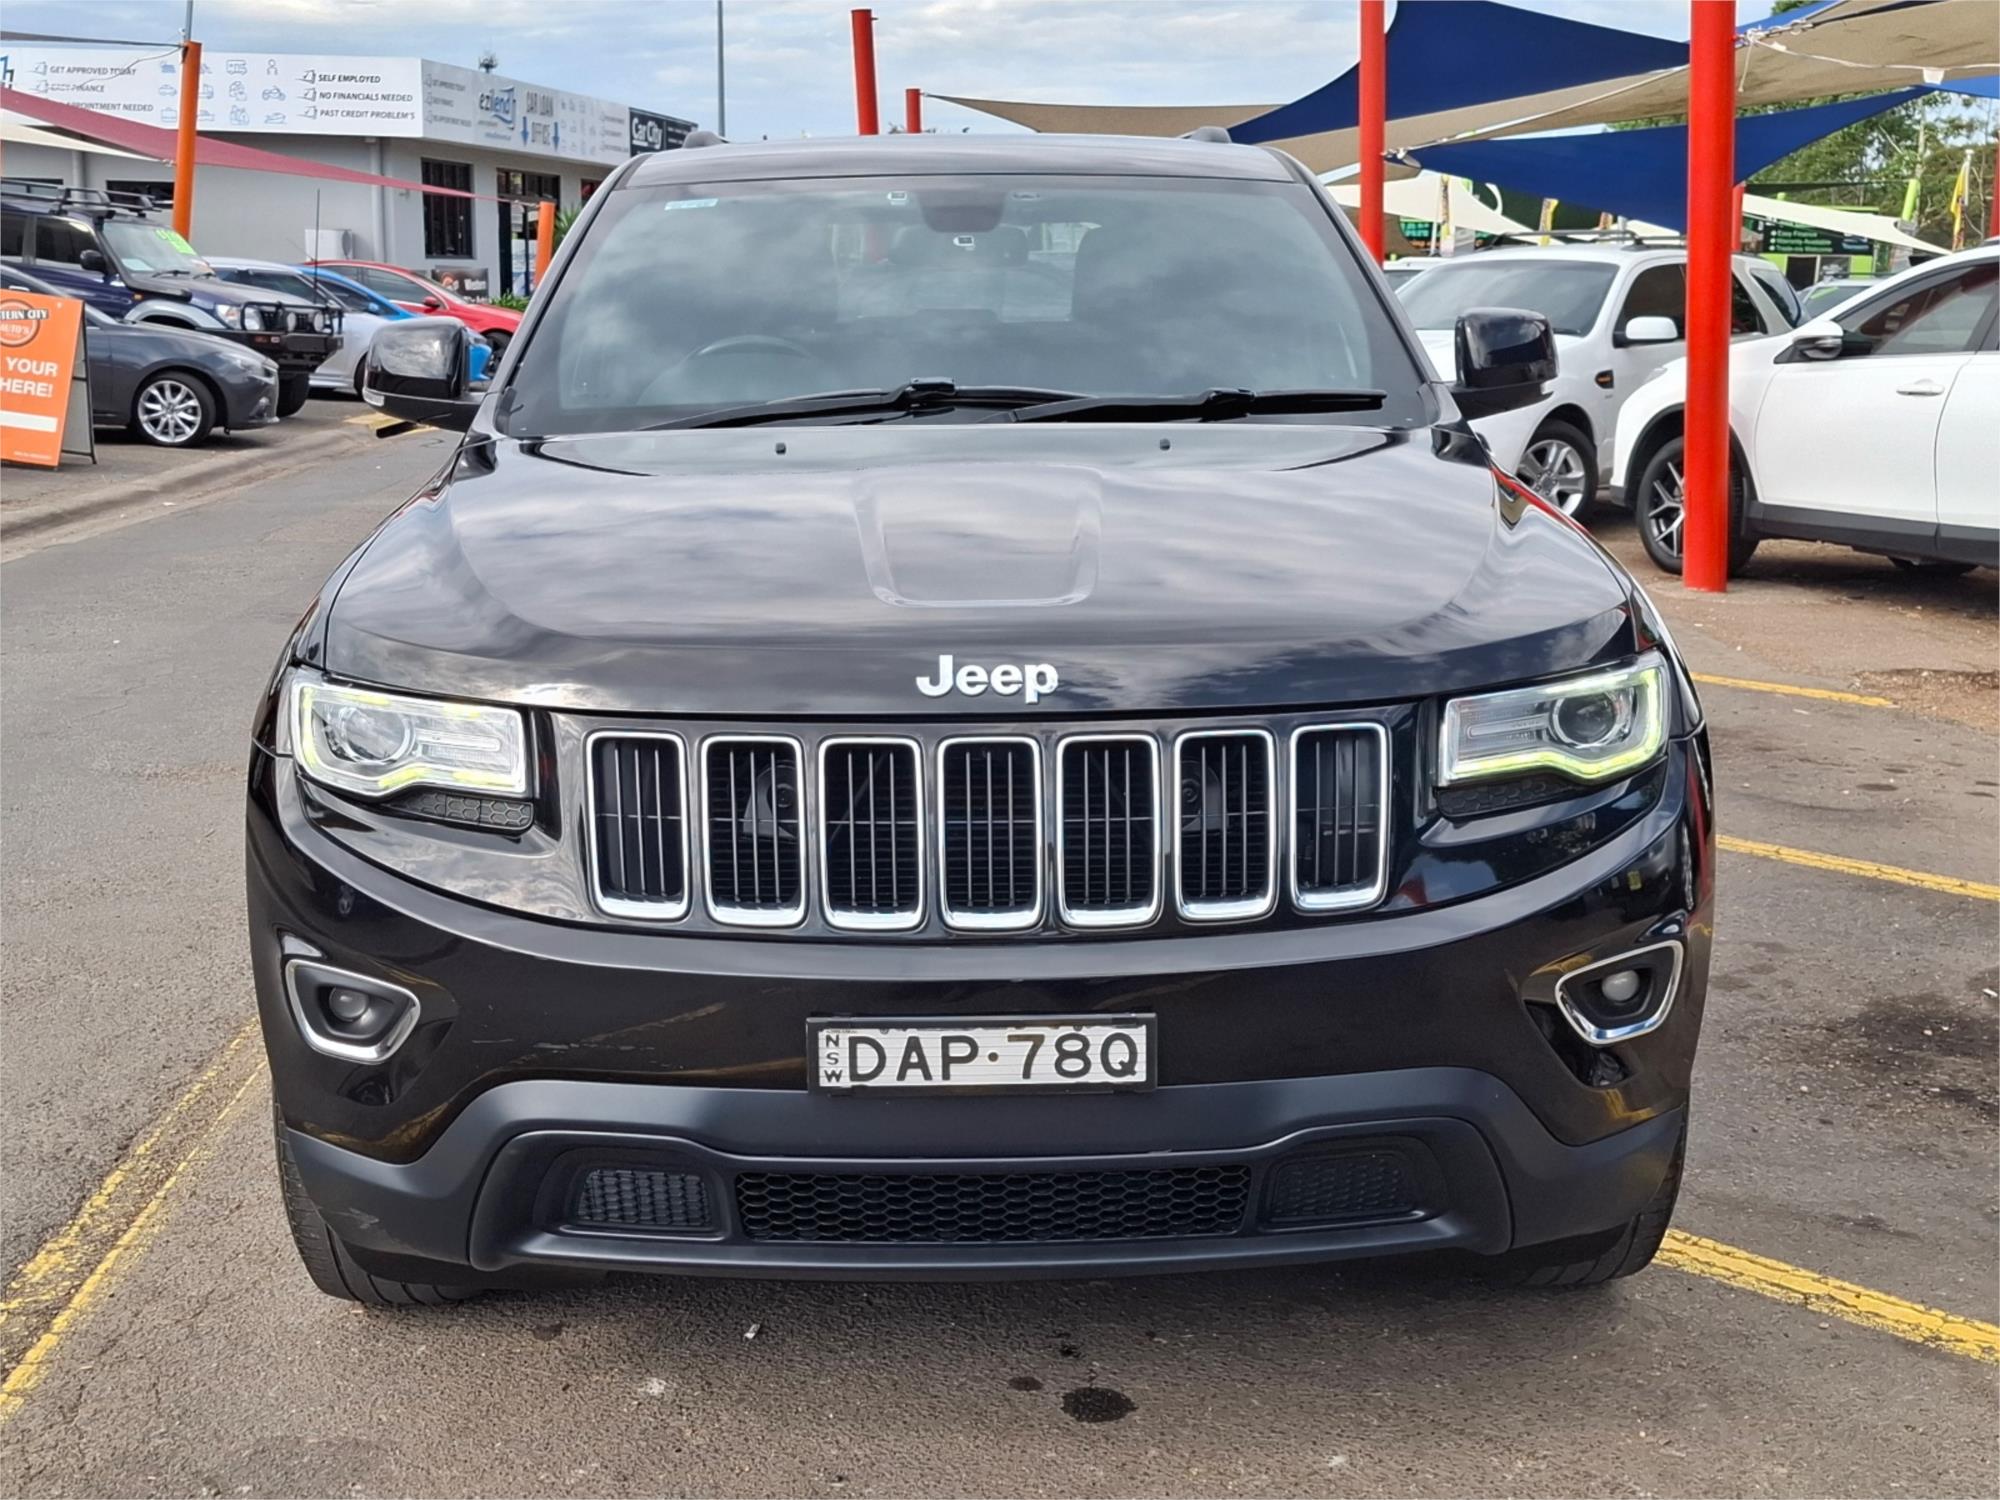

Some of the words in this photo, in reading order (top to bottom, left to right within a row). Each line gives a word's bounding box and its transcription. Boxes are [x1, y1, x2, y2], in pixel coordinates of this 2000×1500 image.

[49, 65, 65, 76] GET
[67, 66, 108, 76] APPROVED
[318, 74, 336, 82] SELF
[338, 75, 381, 84] EMPLOYED
[319, 91, 332, 100] NO
[333, 91, 379, 101] FINANCIALS
[381, 94, 413, 102] NEEDED
[122, 104, 154, 112] NEEDED
[320, 109, 339, 118] PAST
[341, 110, 369, 118] CREDIT
[27, 309, 48, 320] CITY
[6, 356, 58, 377] YOUR
[0, 376, 54, 398] HERE!
[916, 654, 1059, 704] Jeep
